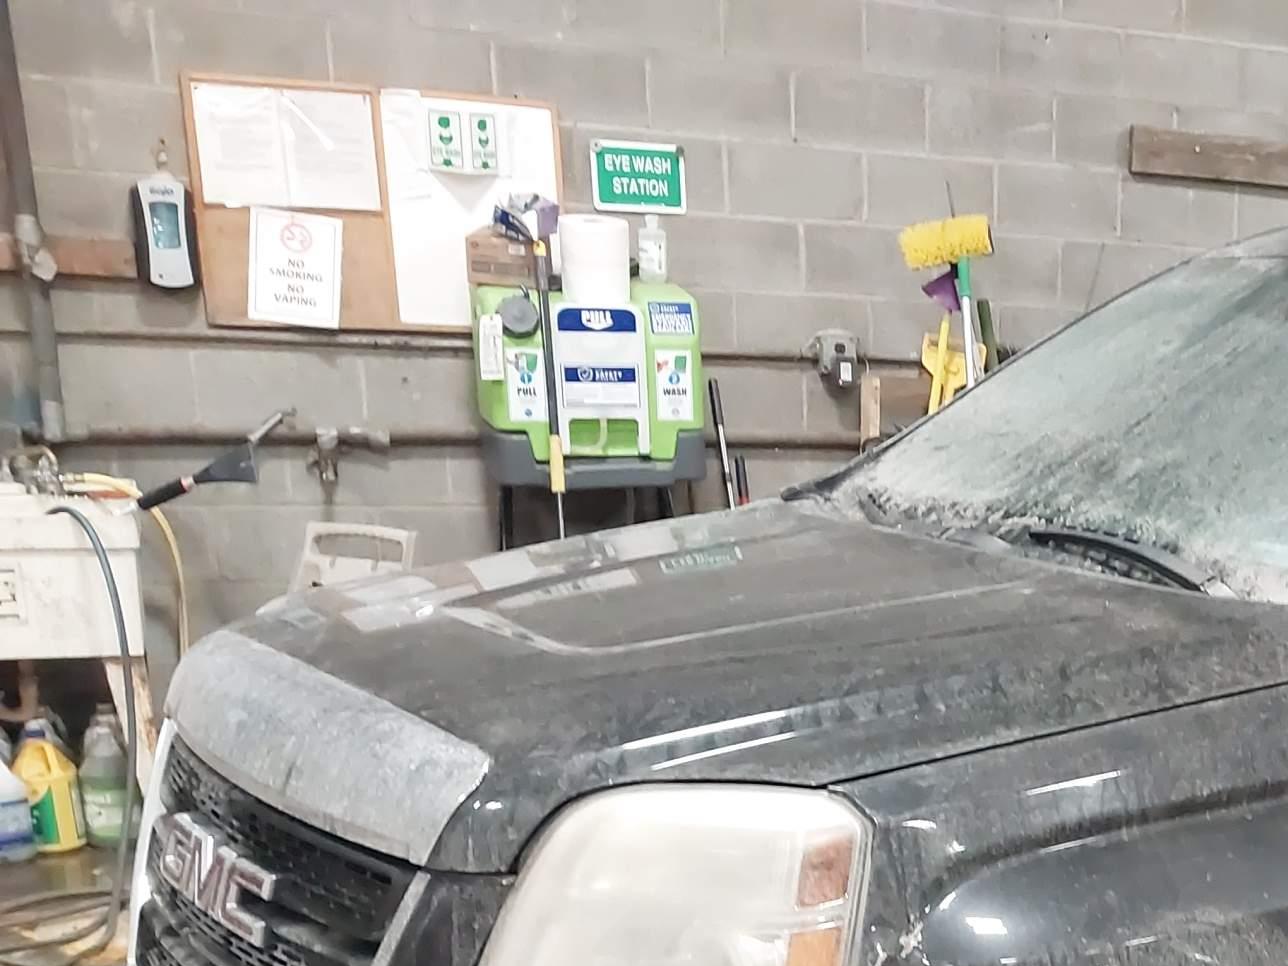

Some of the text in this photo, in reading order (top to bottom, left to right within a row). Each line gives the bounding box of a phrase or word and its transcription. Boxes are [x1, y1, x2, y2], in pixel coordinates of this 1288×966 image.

[604, 153, 672, 175] EYE WASH
[612, 176, 669, 197] STATION
[287, 258, 305, 270] NO
[269, 267, 324, 283] SMOKING
[287, 284, 305, 295] NO
[274, 293, 318, 308] VAPING
[663, 387, 687, 397] WASH
[154, 812, 276, 948] GMC
